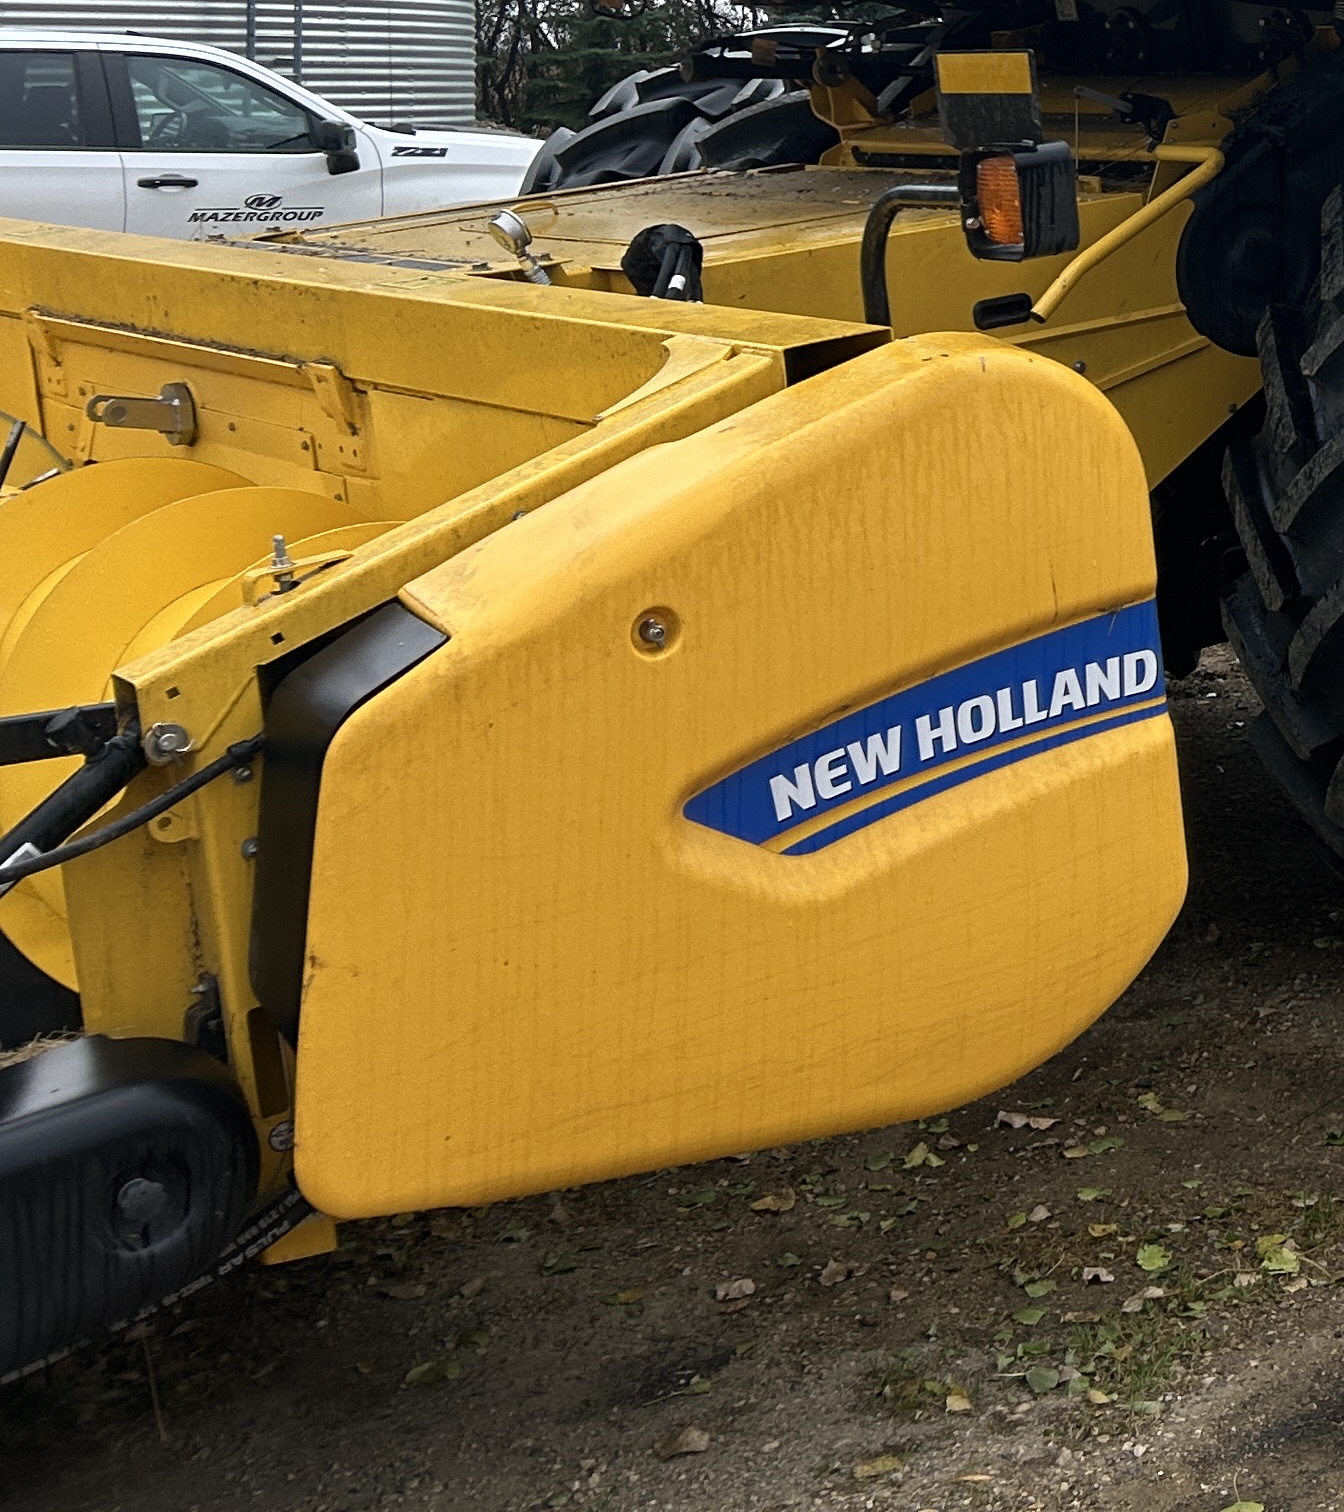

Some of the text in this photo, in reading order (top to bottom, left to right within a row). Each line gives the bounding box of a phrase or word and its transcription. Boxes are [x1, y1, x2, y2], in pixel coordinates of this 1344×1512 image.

[187, 210, 324, 223] MAZERGROUP
[768, 648, 1159, 823] NEW HOLLAND
